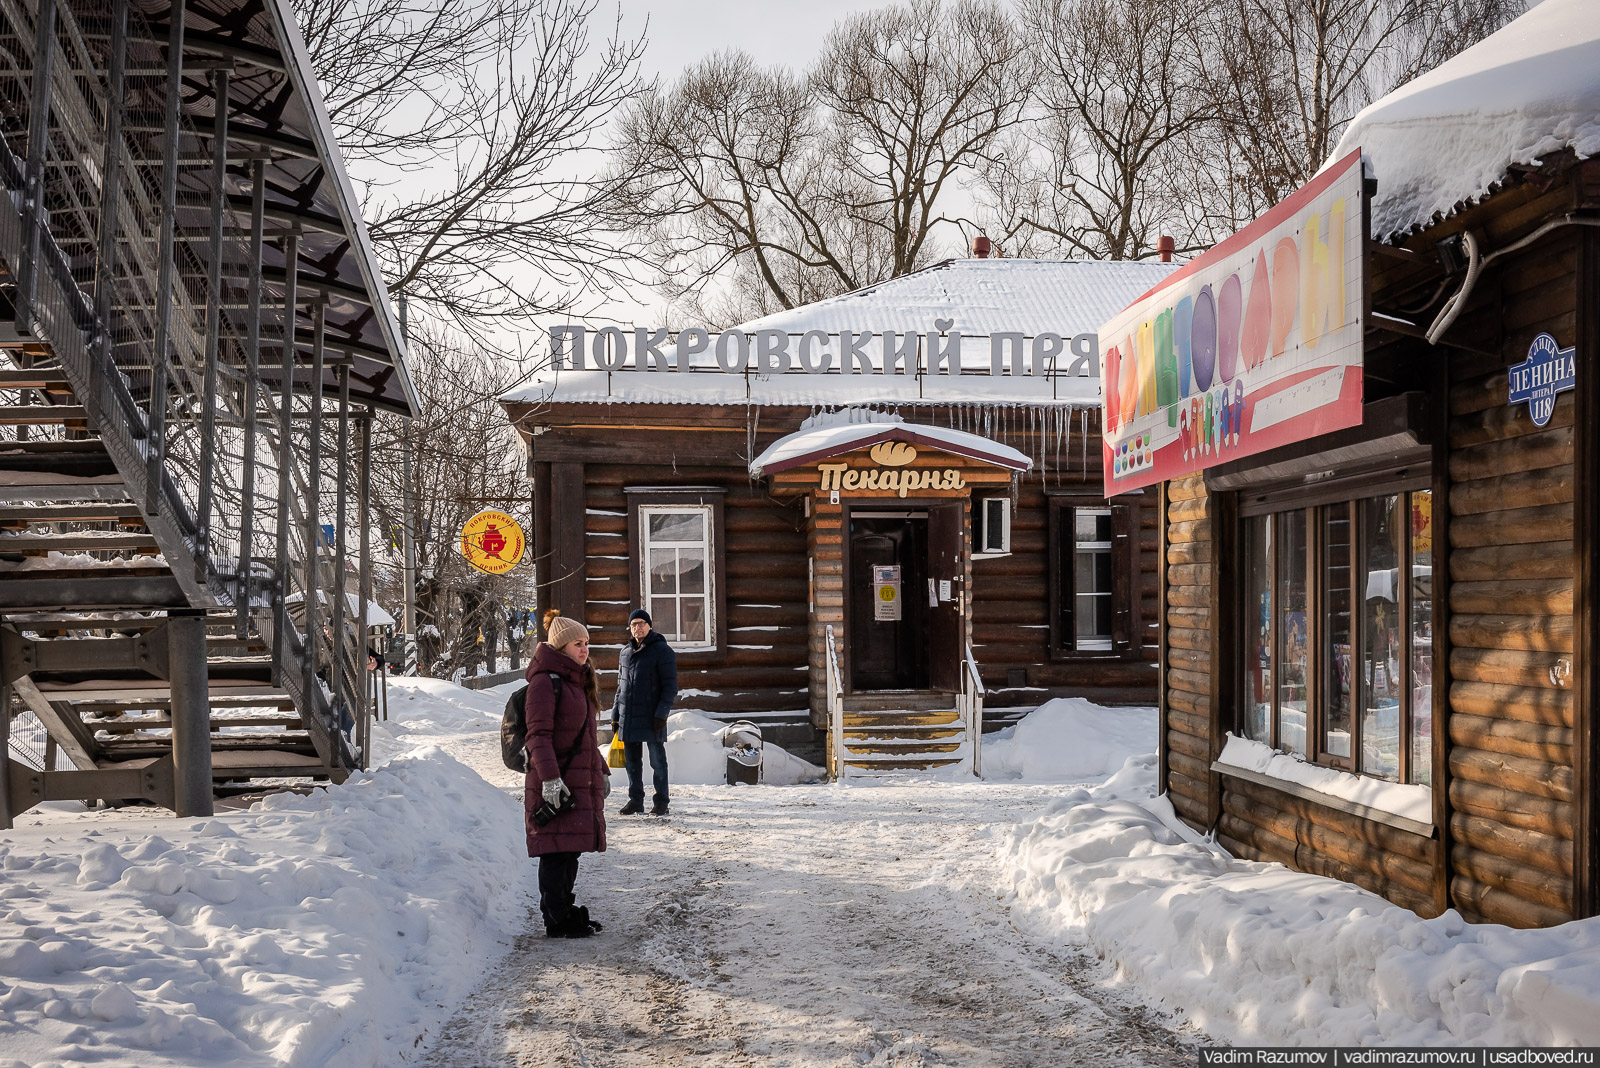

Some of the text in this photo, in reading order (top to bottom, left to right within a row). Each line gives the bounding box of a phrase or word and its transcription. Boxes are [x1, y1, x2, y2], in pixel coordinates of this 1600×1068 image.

[1105, 196, 1346, 436] КАНЦТОВАРЫ
[550, 319, 1100, 377] ПОКРОВСКИЙ ПРЯ
[1527, 338, 1555, 363] УЛИЦА
[1510, 355, 1576, 393] ЛЕНИНА
[1534, 397, 1551, 419] 118
[817, 462, 966, 498] Пекарня
[469, 513, 516, 528] ПОКРОВСКИЙ
[479, 563, 509, 571] ПРЯНИК
